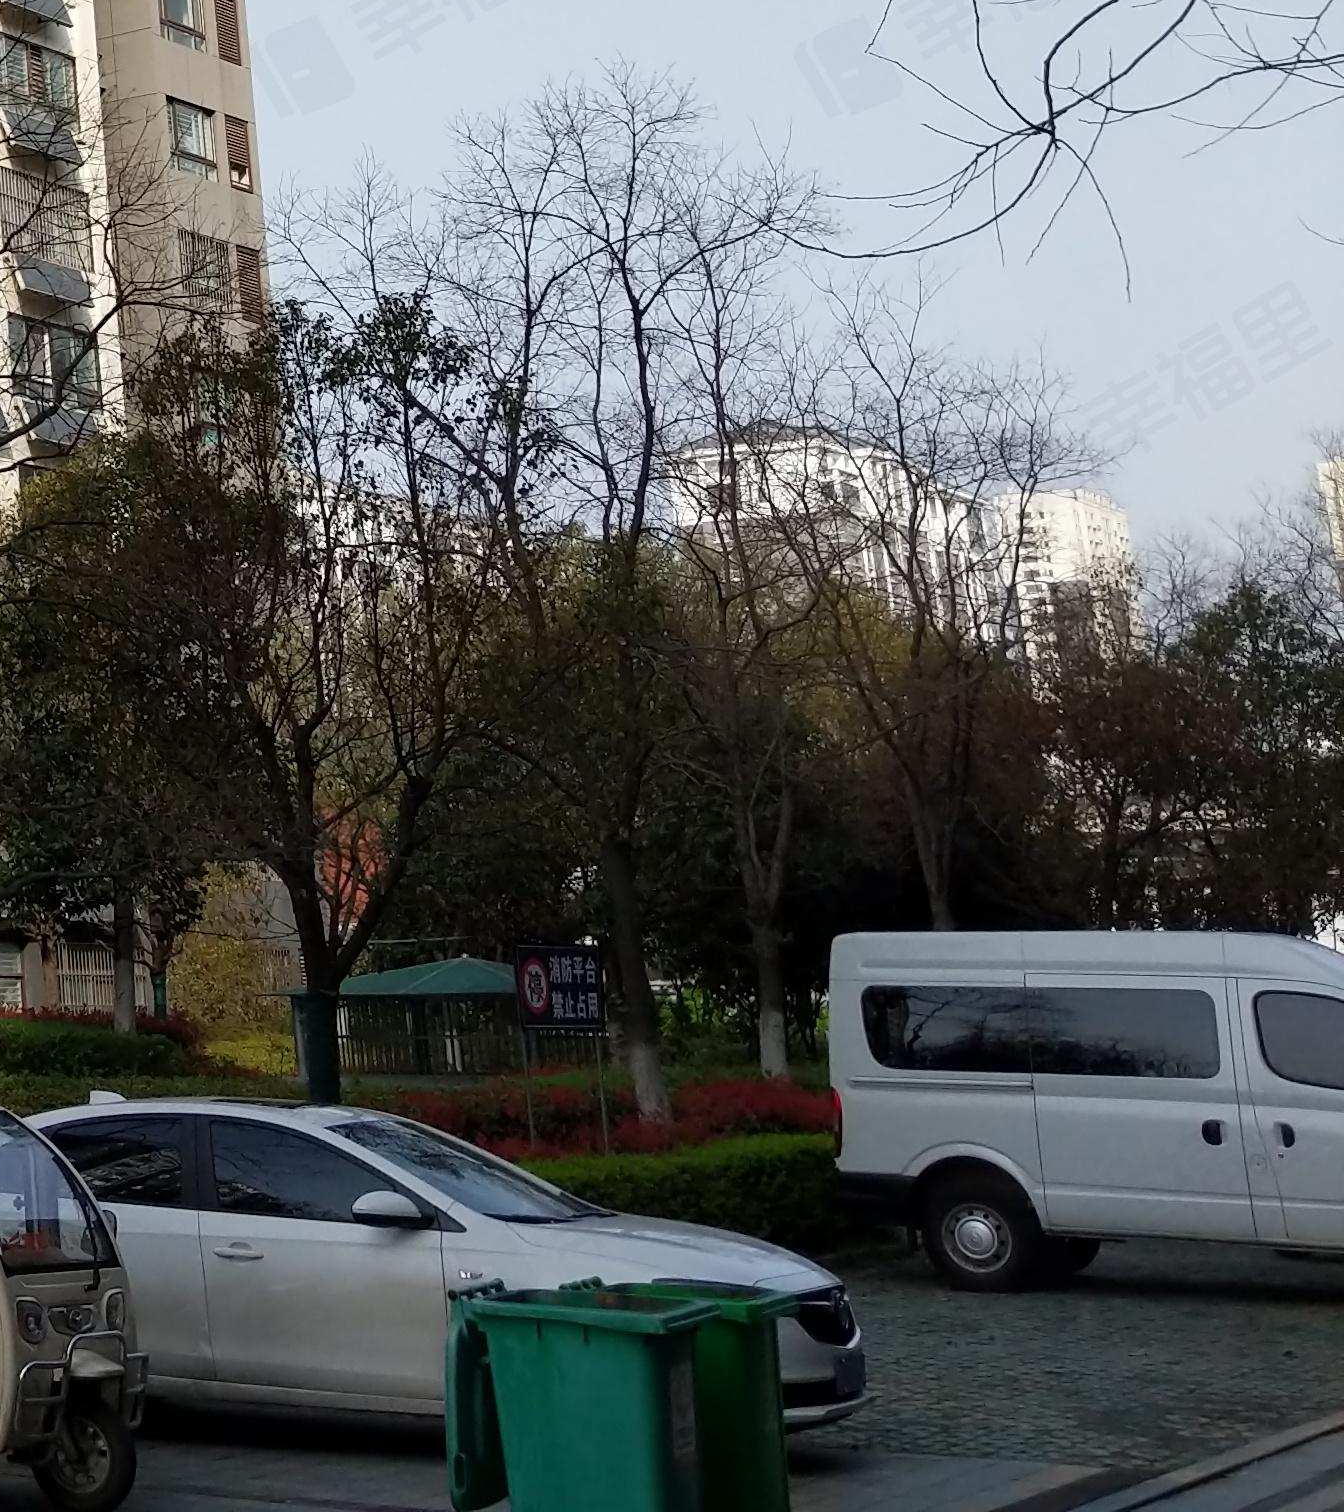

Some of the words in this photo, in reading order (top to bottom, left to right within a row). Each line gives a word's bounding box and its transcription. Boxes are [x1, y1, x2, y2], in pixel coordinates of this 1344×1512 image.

[548, 955, 596, 984] 消防平台
[552, 991, 599, 1019] 禁止占用
